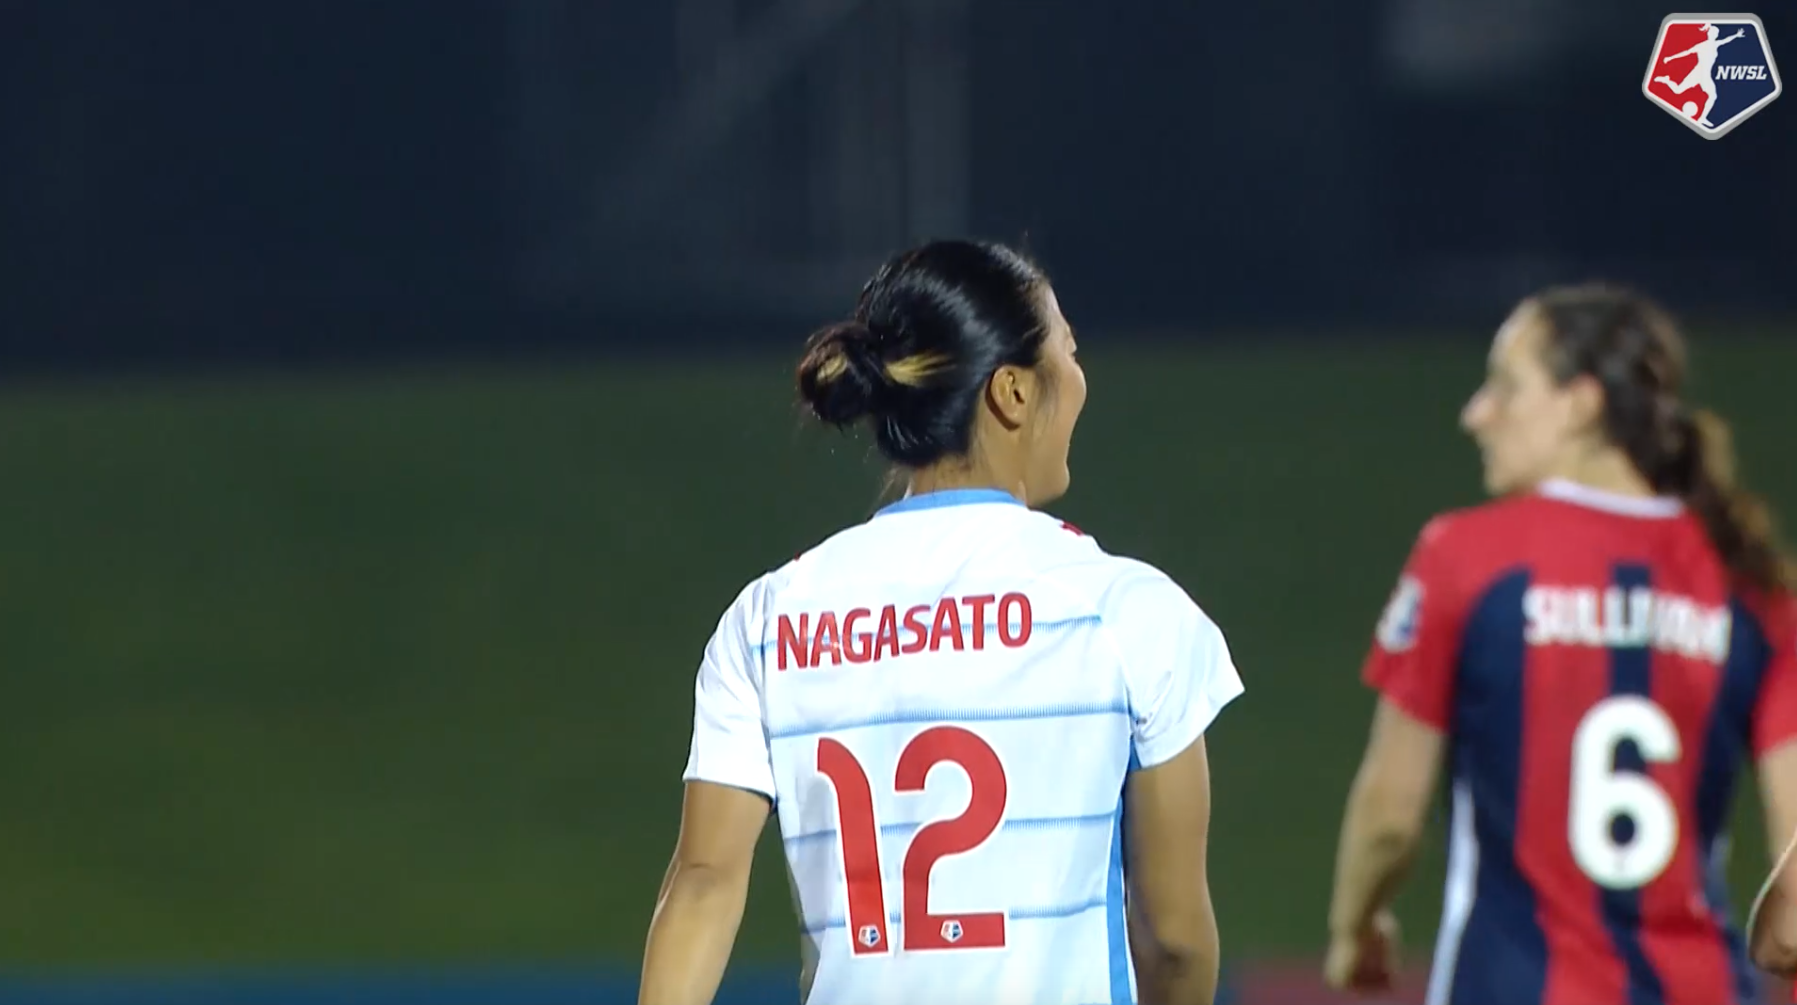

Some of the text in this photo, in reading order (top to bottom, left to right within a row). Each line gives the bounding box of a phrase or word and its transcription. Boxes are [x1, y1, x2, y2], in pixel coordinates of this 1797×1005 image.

[777, 592, 1032, 671] NAGASATO
[816, 725, 1008, 955] 12
[1568, 694, 1681, 889] 6
